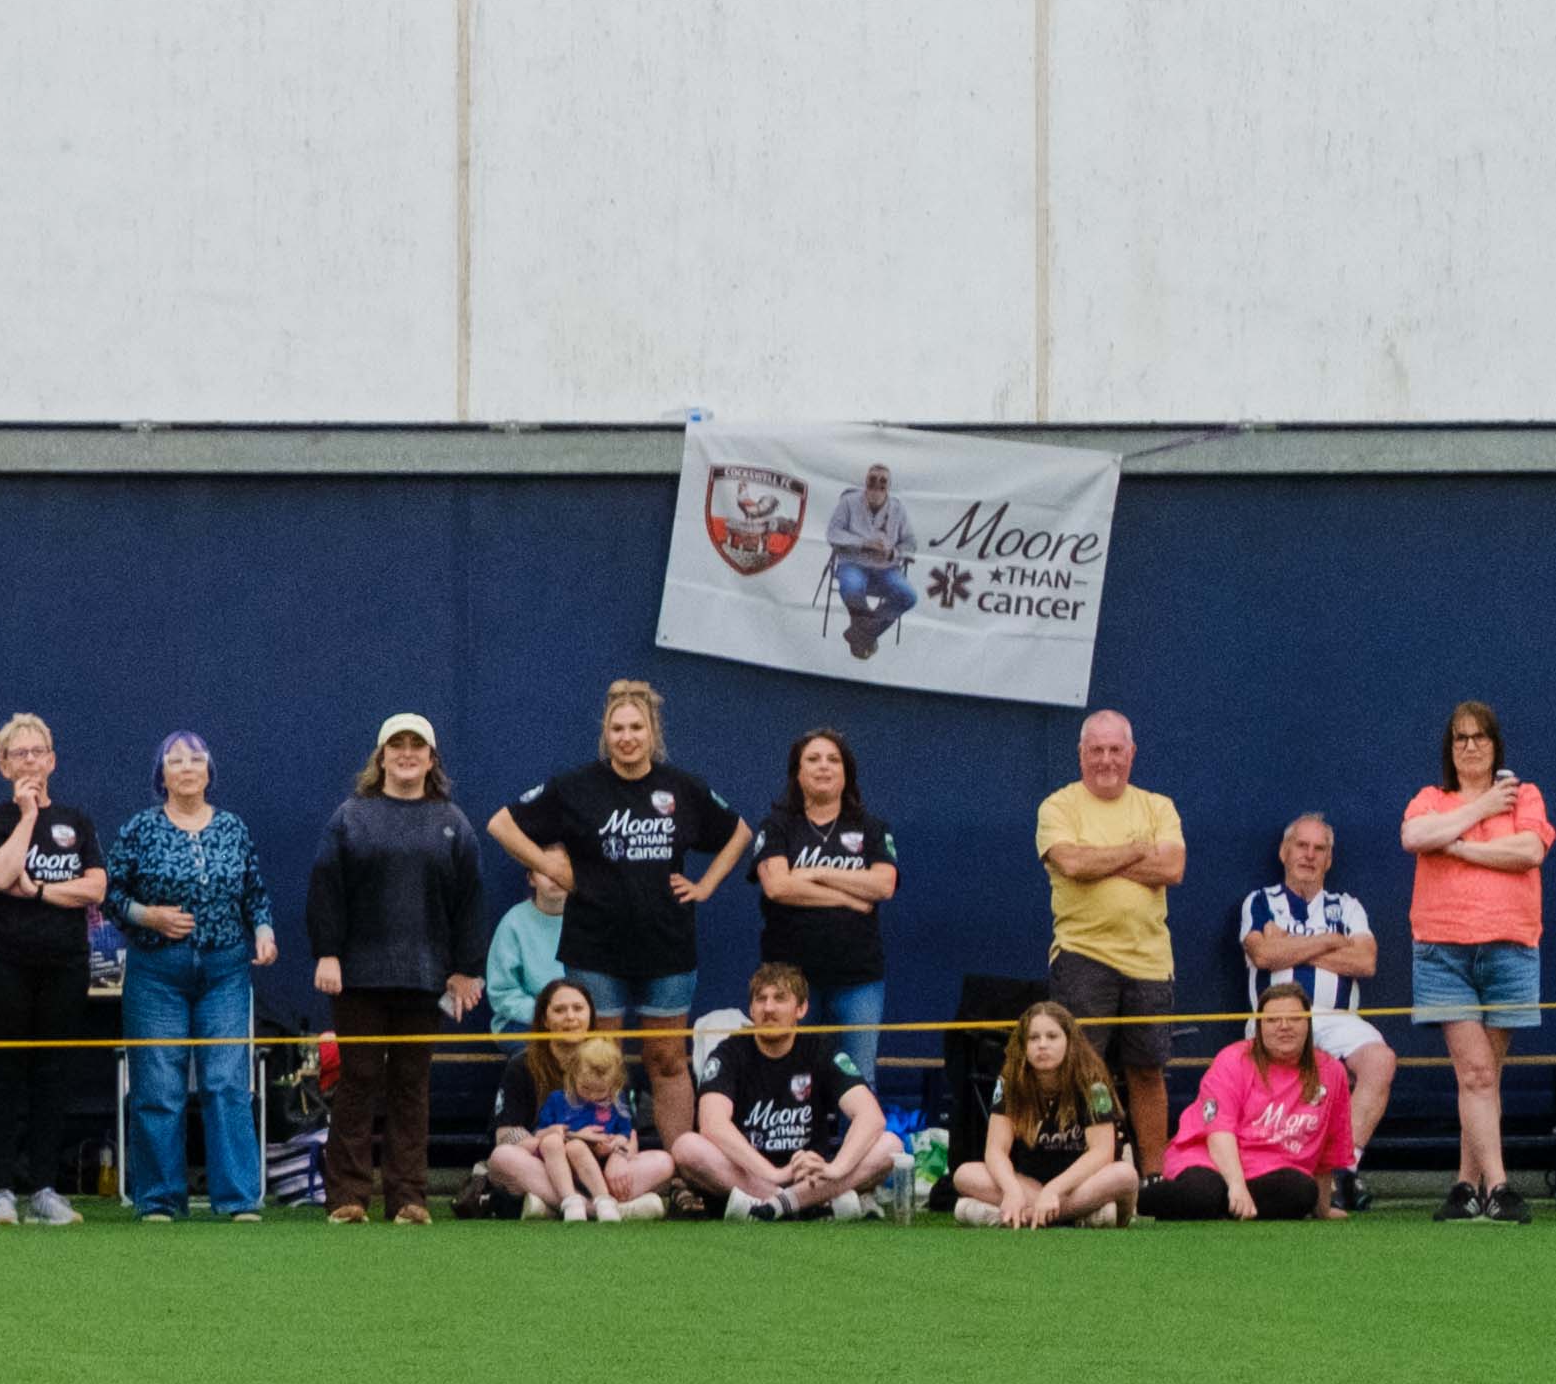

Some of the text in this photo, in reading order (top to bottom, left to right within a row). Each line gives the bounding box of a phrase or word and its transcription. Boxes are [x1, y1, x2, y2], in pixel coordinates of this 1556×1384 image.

[928, 500, 1103, 565] Moore
[977, 590, 1086, 621] cancer
[598, 808, 676, 837] Moore
[626, 846, 673, 861] cancer
[743, 1098, 813, 1130] Moore
[1252, 1101, 1319, 1131] More
